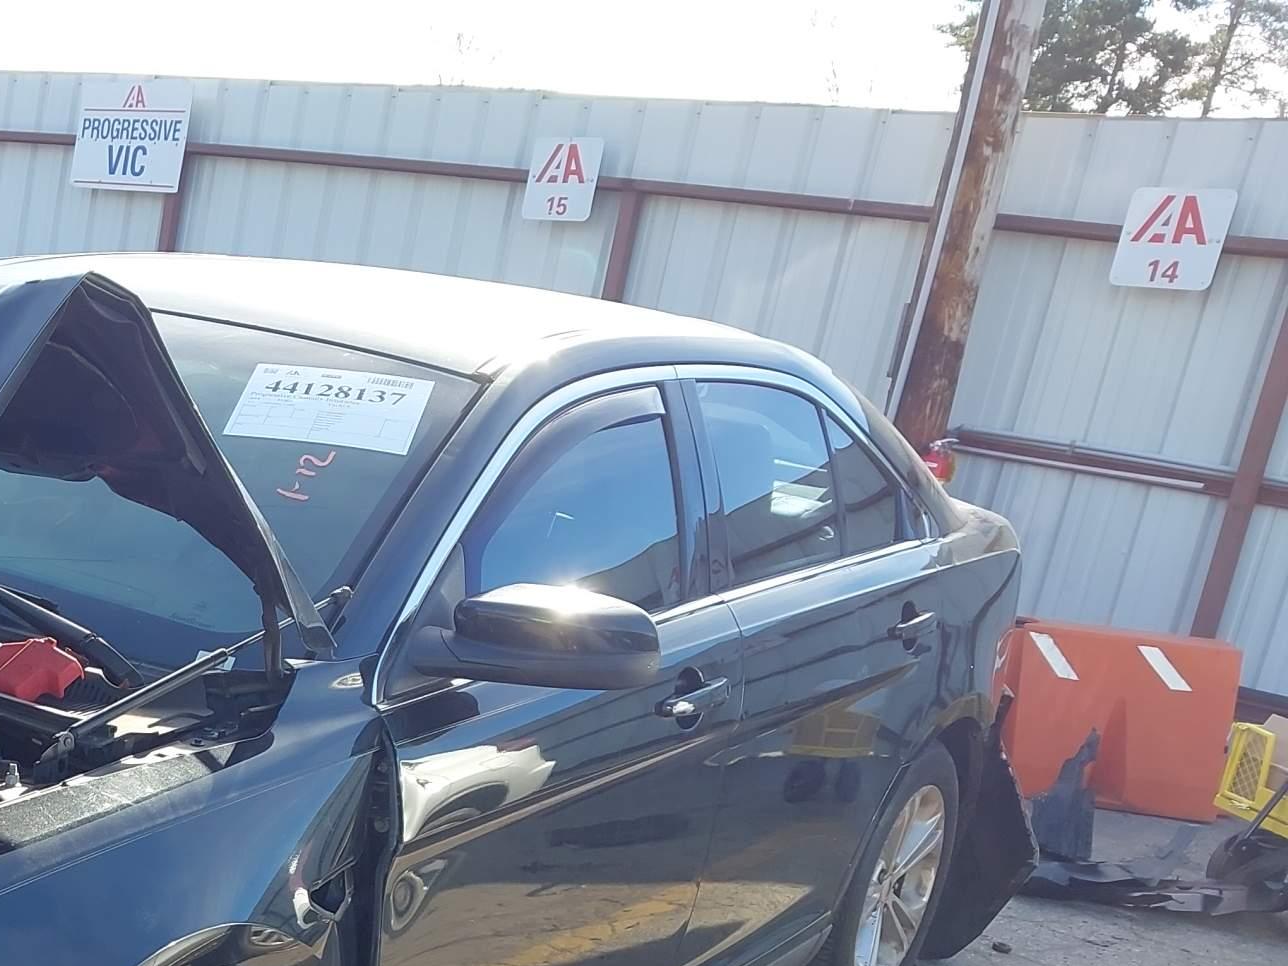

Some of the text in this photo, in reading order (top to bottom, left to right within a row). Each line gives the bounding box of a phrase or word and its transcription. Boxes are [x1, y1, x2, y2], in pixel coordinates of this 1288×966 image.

[81, 118, 183, 142] PROGRESSIVE
[108, 145, 148, 177] VIC
[546, 196, 569, 216] 15
[1148, 259, 1180, 283] 14
[265, 379, 408, 406] 44128137
